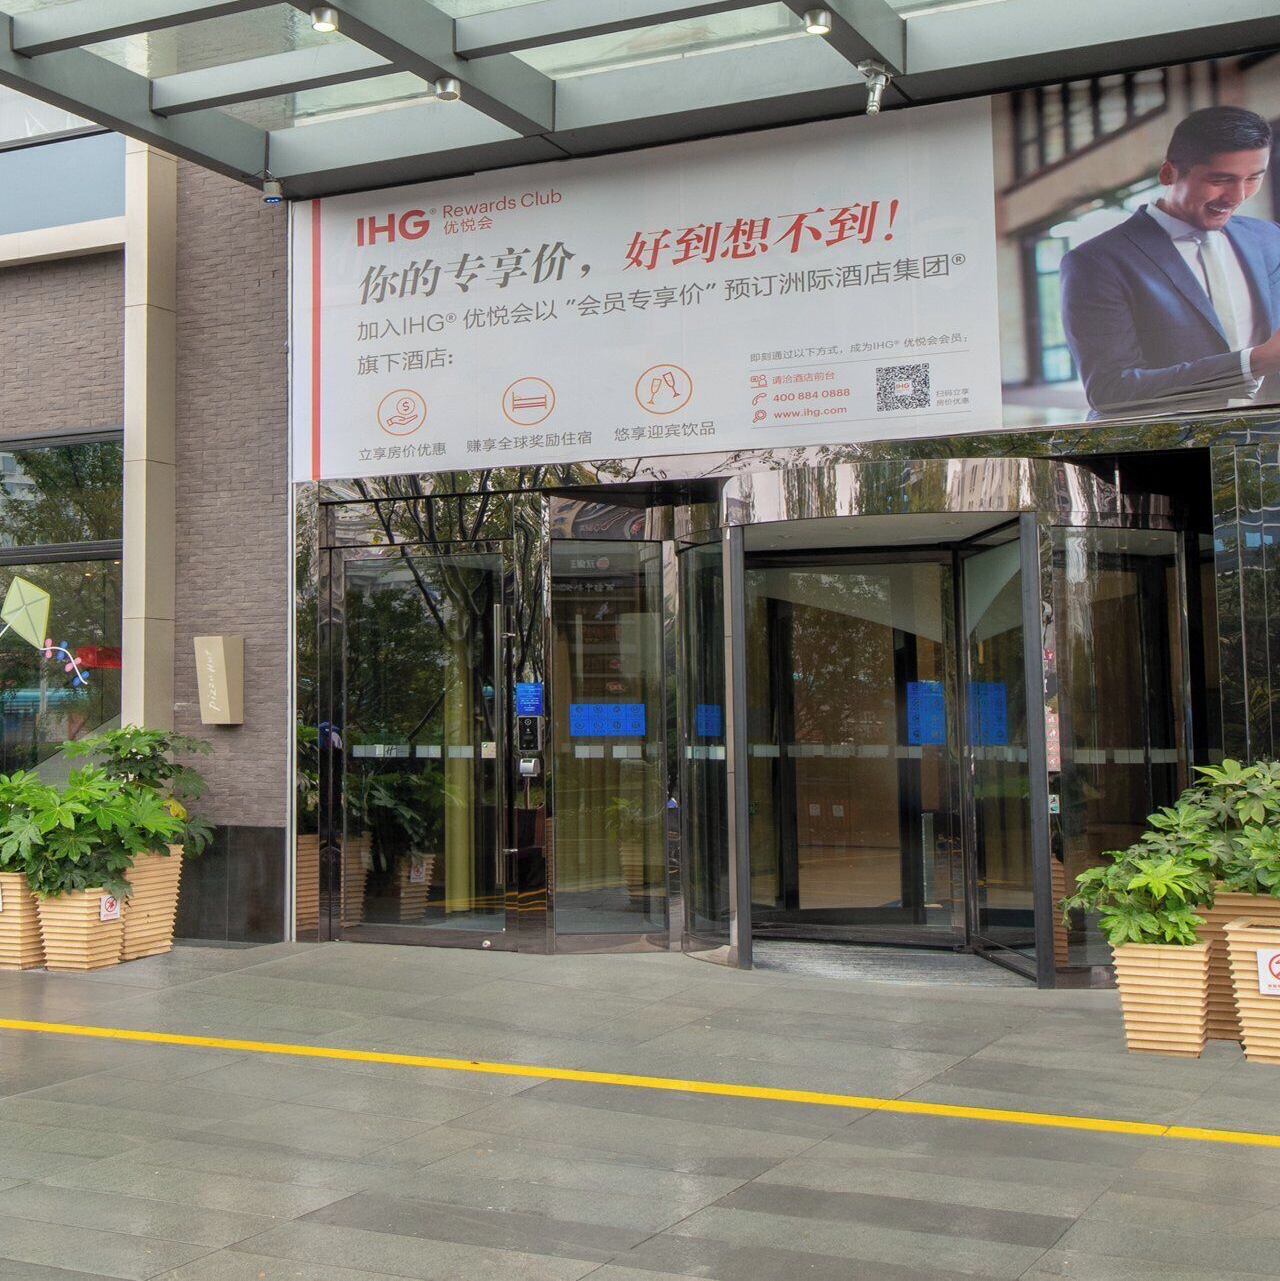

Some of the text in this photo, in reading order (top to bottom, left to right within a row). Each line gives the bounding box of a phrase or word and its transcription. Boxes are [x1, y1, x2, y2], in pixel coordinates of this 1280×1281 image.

[442, 196, 516, 219] Rewards
[520, 189, 562, 206] Club
[443, 216, 494, 235] 优悦会
[772, 371, 835, 385] 请洽酒店前台
[773, 388, 851, 403] 400 884 0888
[773, 405, 847, 420] www.ihg.com
[614, 421, 716, 441] 悠享迎宾饮品
[466, 430, 593, 454] 赚享全球奖励住宿
[359, 442, 447, 462] 立享房价优惠
